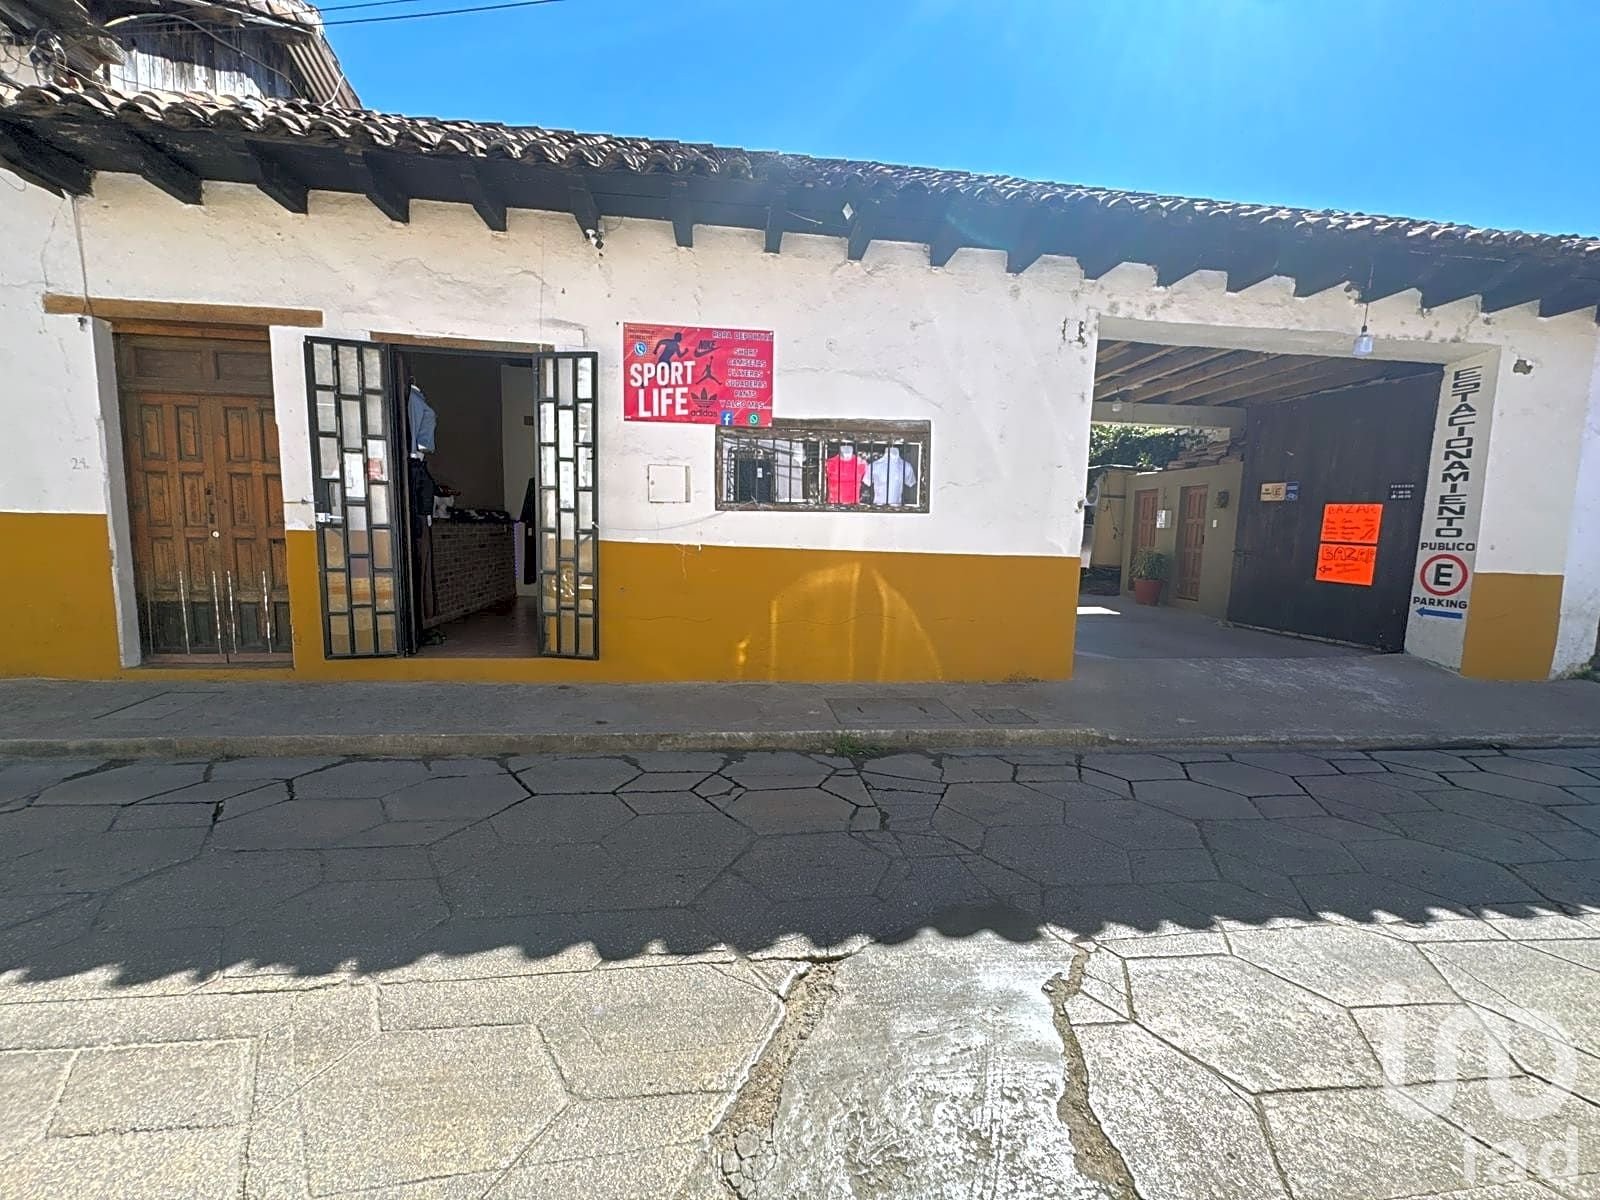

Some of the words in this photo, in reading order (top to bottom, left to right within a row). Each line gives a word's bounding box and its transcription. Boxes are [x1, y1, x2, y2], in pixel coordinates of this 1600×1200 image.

[629, 360, 696, 388] SPORT
[637, 386, 690, 418] LIFE
[734, 389, 757, 398] PANTS
[1435, 365, 1482, 539] ESTACIONAMIENTO
[1420, 542, 1476, 552] PUBLICO
[1433, 564, 1454, 587] E
[1413, 596, 1468, 610] PARKING
